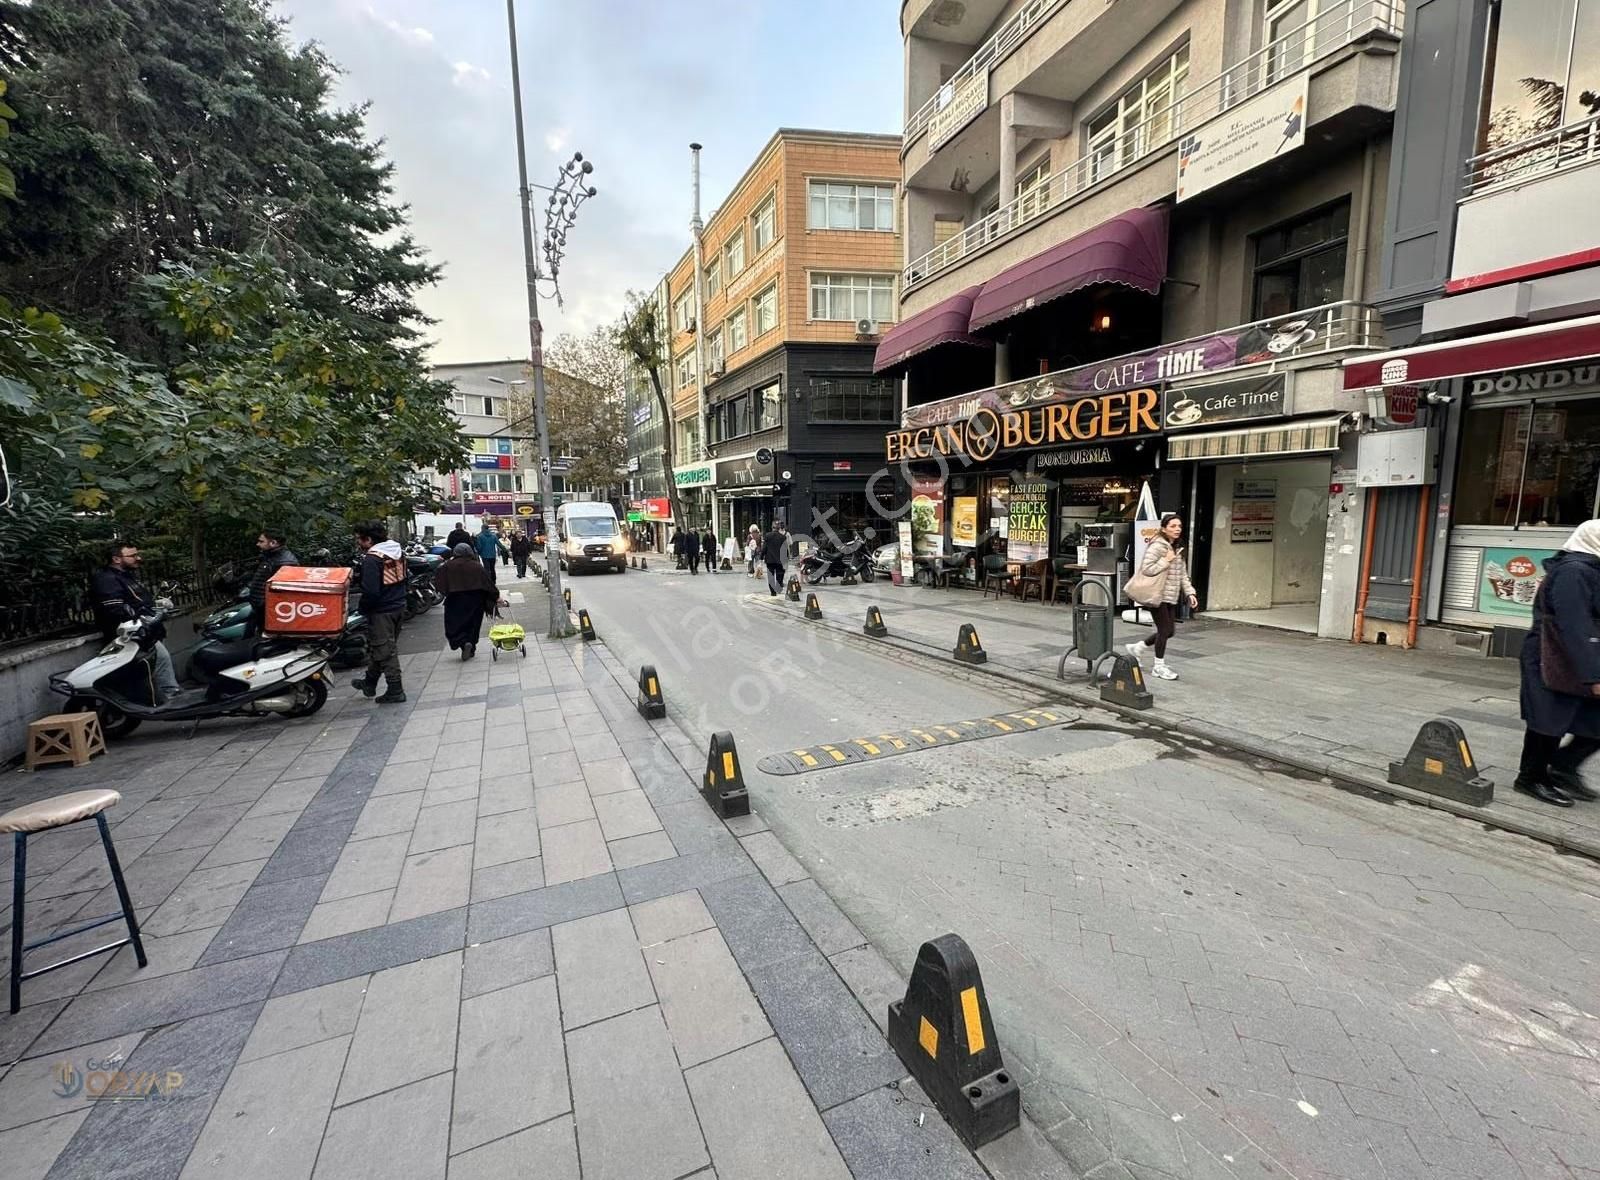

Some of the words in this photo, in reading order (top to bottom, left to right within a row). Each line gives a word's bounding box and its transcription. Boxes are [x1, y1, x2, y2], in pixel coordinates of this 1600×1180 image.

[1094, 361, 1145, 391] CAFE
[1157, 347, 1205, 378] TİME
[1382, 370, 1407, 381] KING
[1392, 384, 1418, 398] BURGER
[1204, 395, 1237, 412] Cafe
[1239, 389, 1279, 407] Time
[1391, 397, 1417, 414] KING
[927, 405, 951, 423] CAFE
[886, 421, 964, 462] ERCAN
[1002, 388, 1160, 448] BURGER
[1037, 448, 1112, 468] DONDURMA
[1010, 484, 1026, 494] FAST
[1028, 483, 1047, 493] FOOD
[1010, 501, 1047, 515] GERÇEK
[1010, 514, 1047, 531] STEAK
[1009, 530, 1047, 542] BURGER
[1232, 528, 1252, 538] Cafe
[275, 601, 324, 623] go
